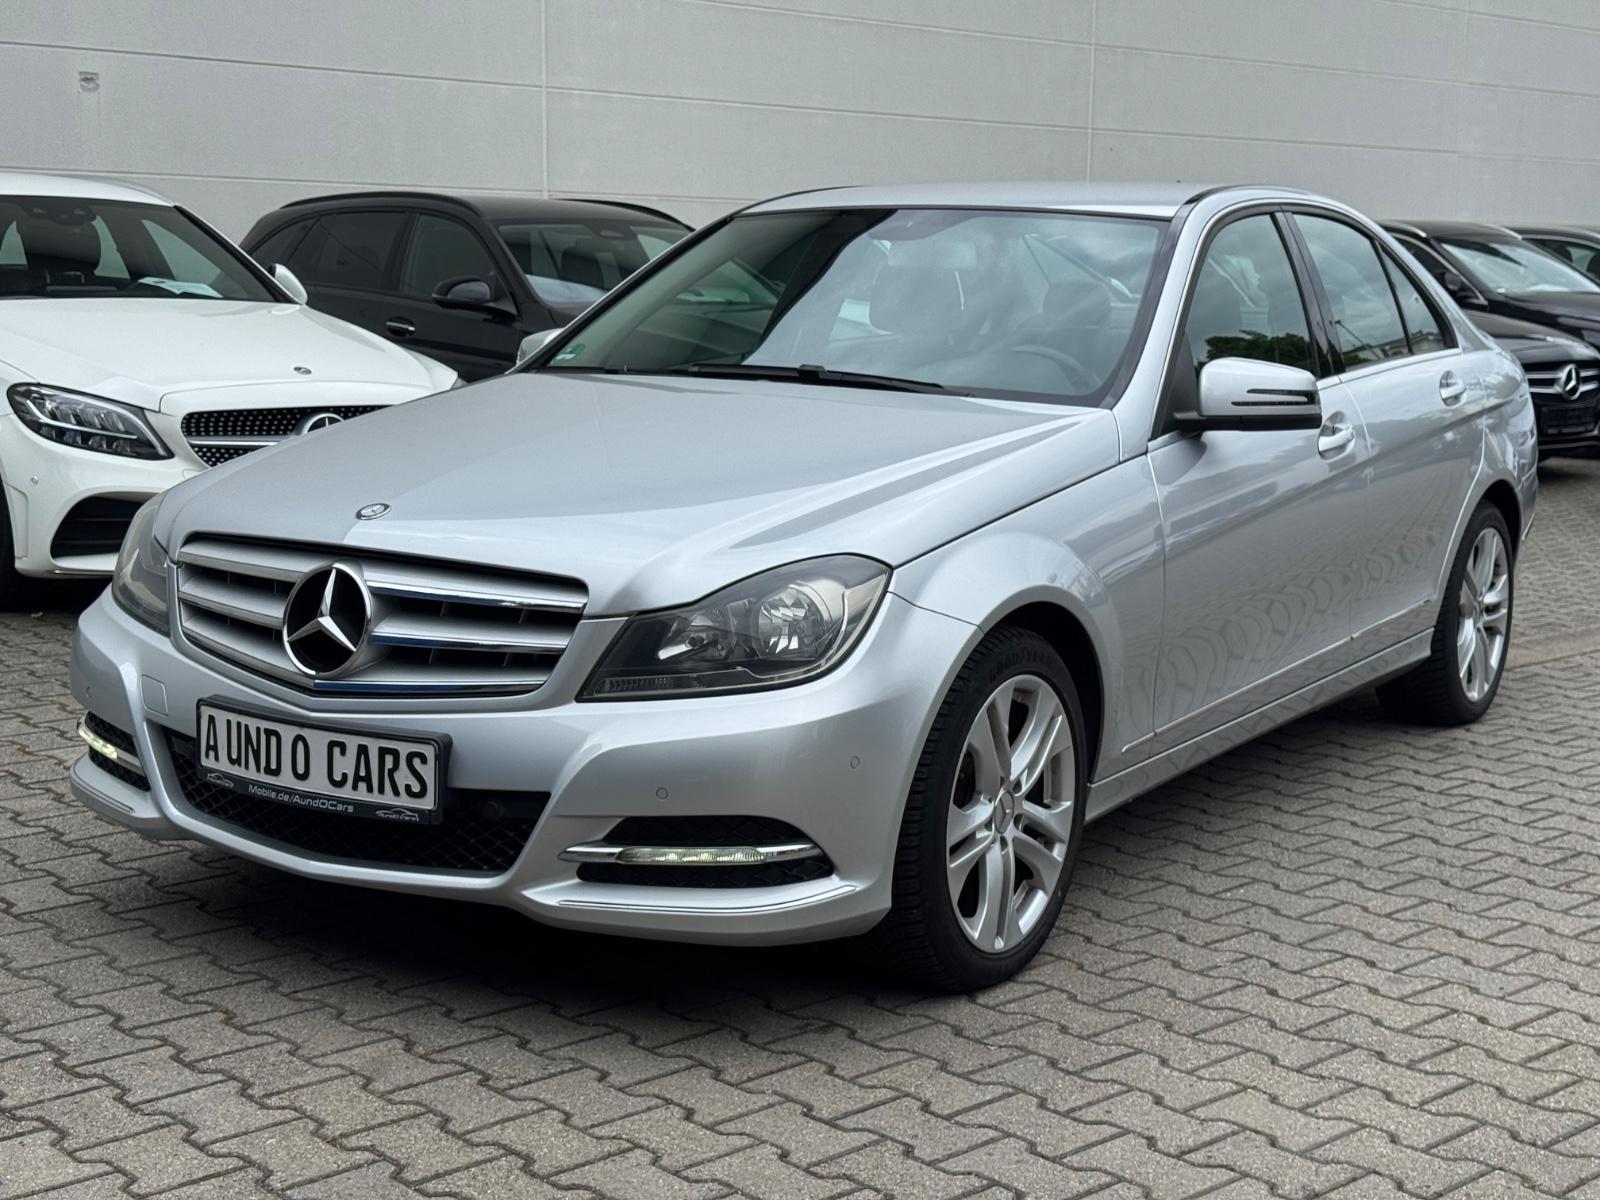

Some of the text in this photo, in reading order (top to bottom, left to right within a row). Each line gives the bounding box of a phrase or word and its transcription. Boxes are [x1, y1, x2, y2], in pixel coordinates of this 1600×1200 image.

[205, 714, 428, 799] A UND O CARS
[248, 784, 354, 813] Mobile.de/AundOCars
